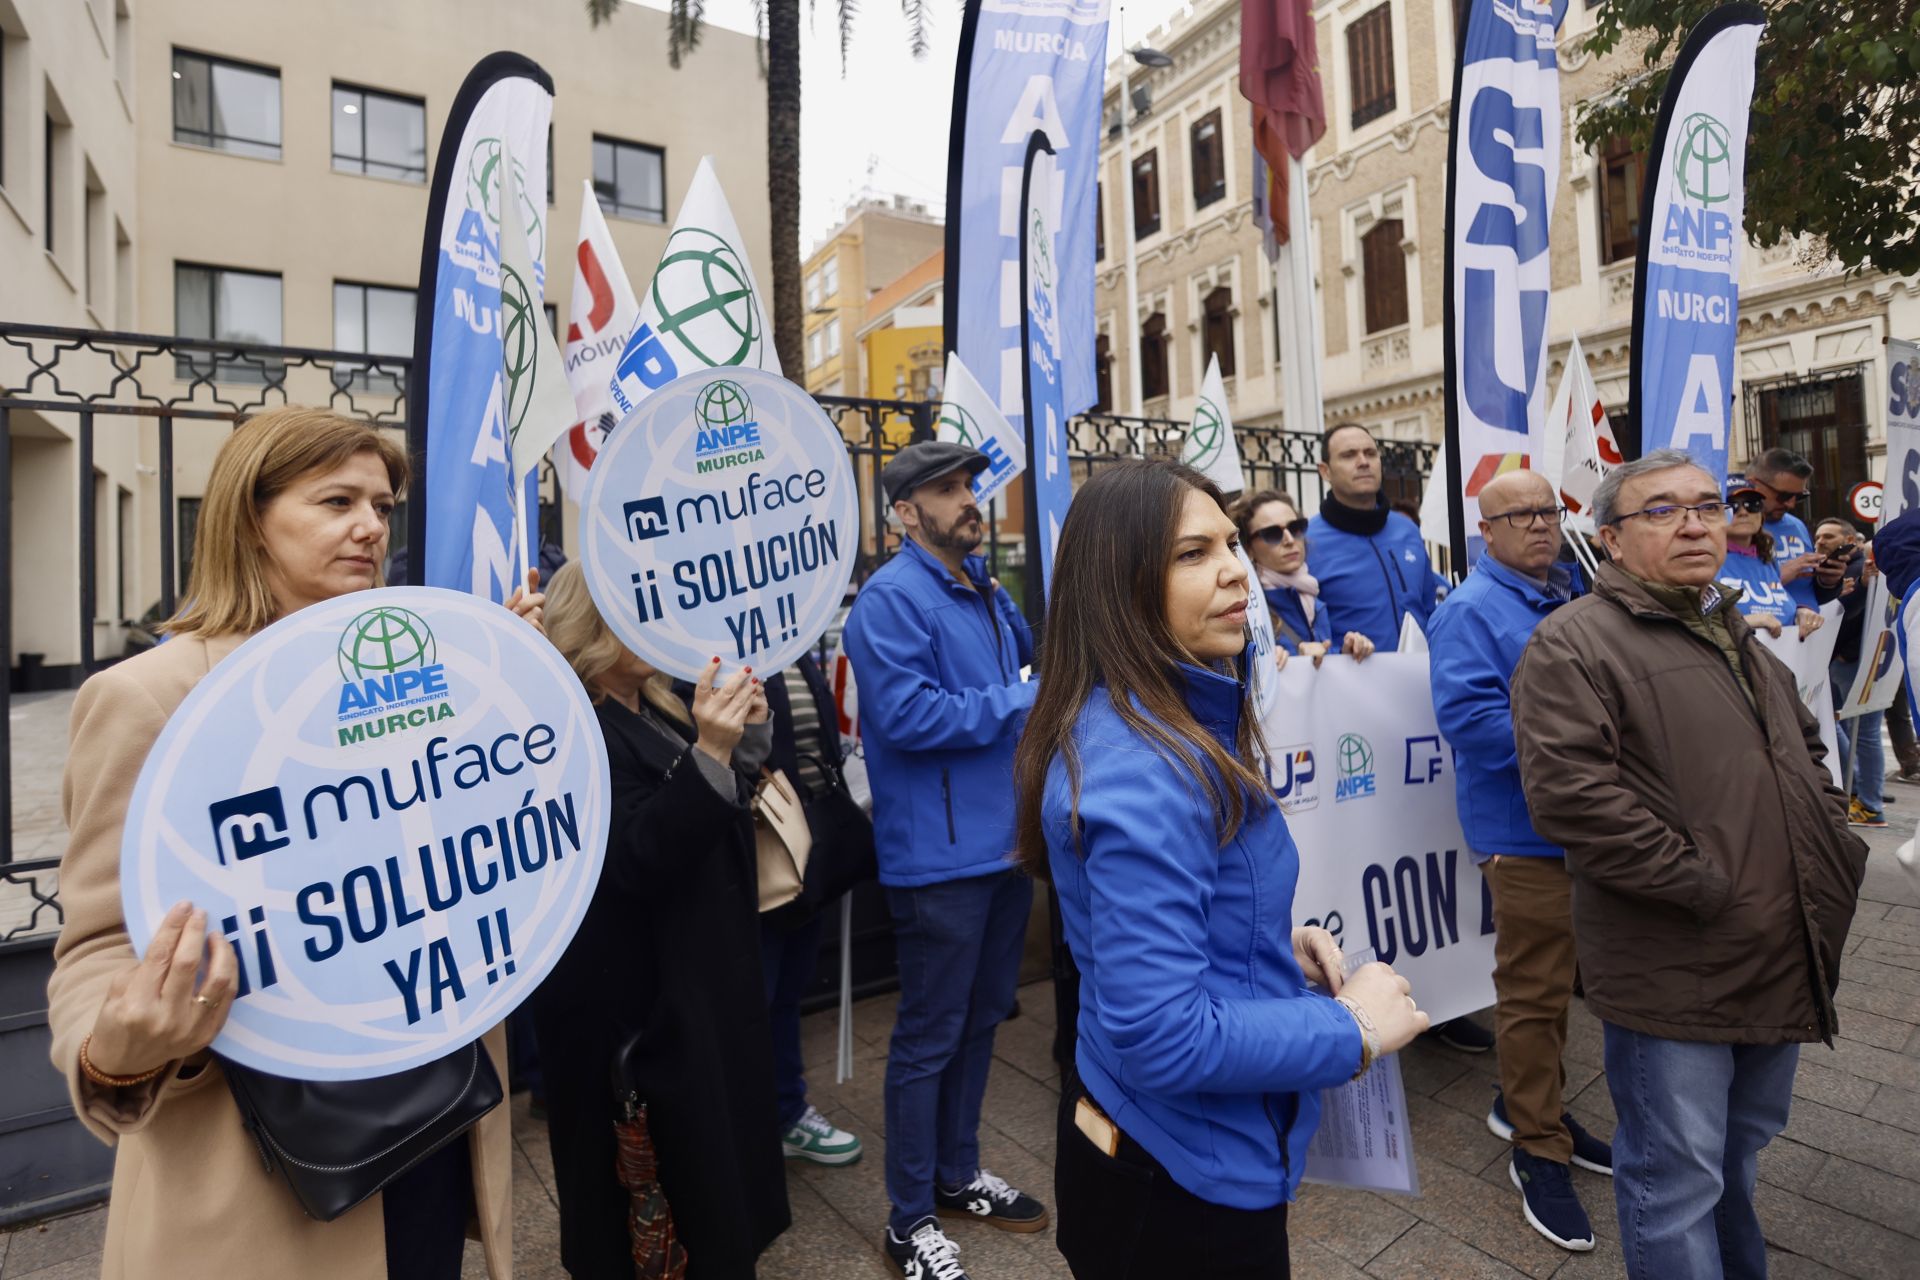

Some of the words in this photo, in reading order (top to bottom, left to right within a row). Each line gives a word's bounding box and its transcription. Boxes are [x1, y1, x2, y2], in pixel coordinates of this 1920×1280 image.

[994, 29, 1088, 61] MURCIA
[695, 421, 760, 452] ANPE
[696, 448, 765, 474] MURCIA
[676, 468, 826, 533] muface
[672, 514, 840, 611] SOLUCIÓN
[724, 605, 770, 660] YA
[776, 592, 799, 643] !!
[337, 663, 448, 714] ANPE
[338, 706, 384, 722] SINDICATO
[386, 690, 450, 711] INDEPENDIENTE
[337, 702, 455, 747] MURCIA
[303, 723, 556, 840] muface
[1335, 773, 1376, 799] ANPE
[296, 790, 581, 963] SOLUCIÓN
[1361, 849, 1460, 966] CON
[383, 891, 467, 1026] YA
[476, 908, 517, 986] !!
